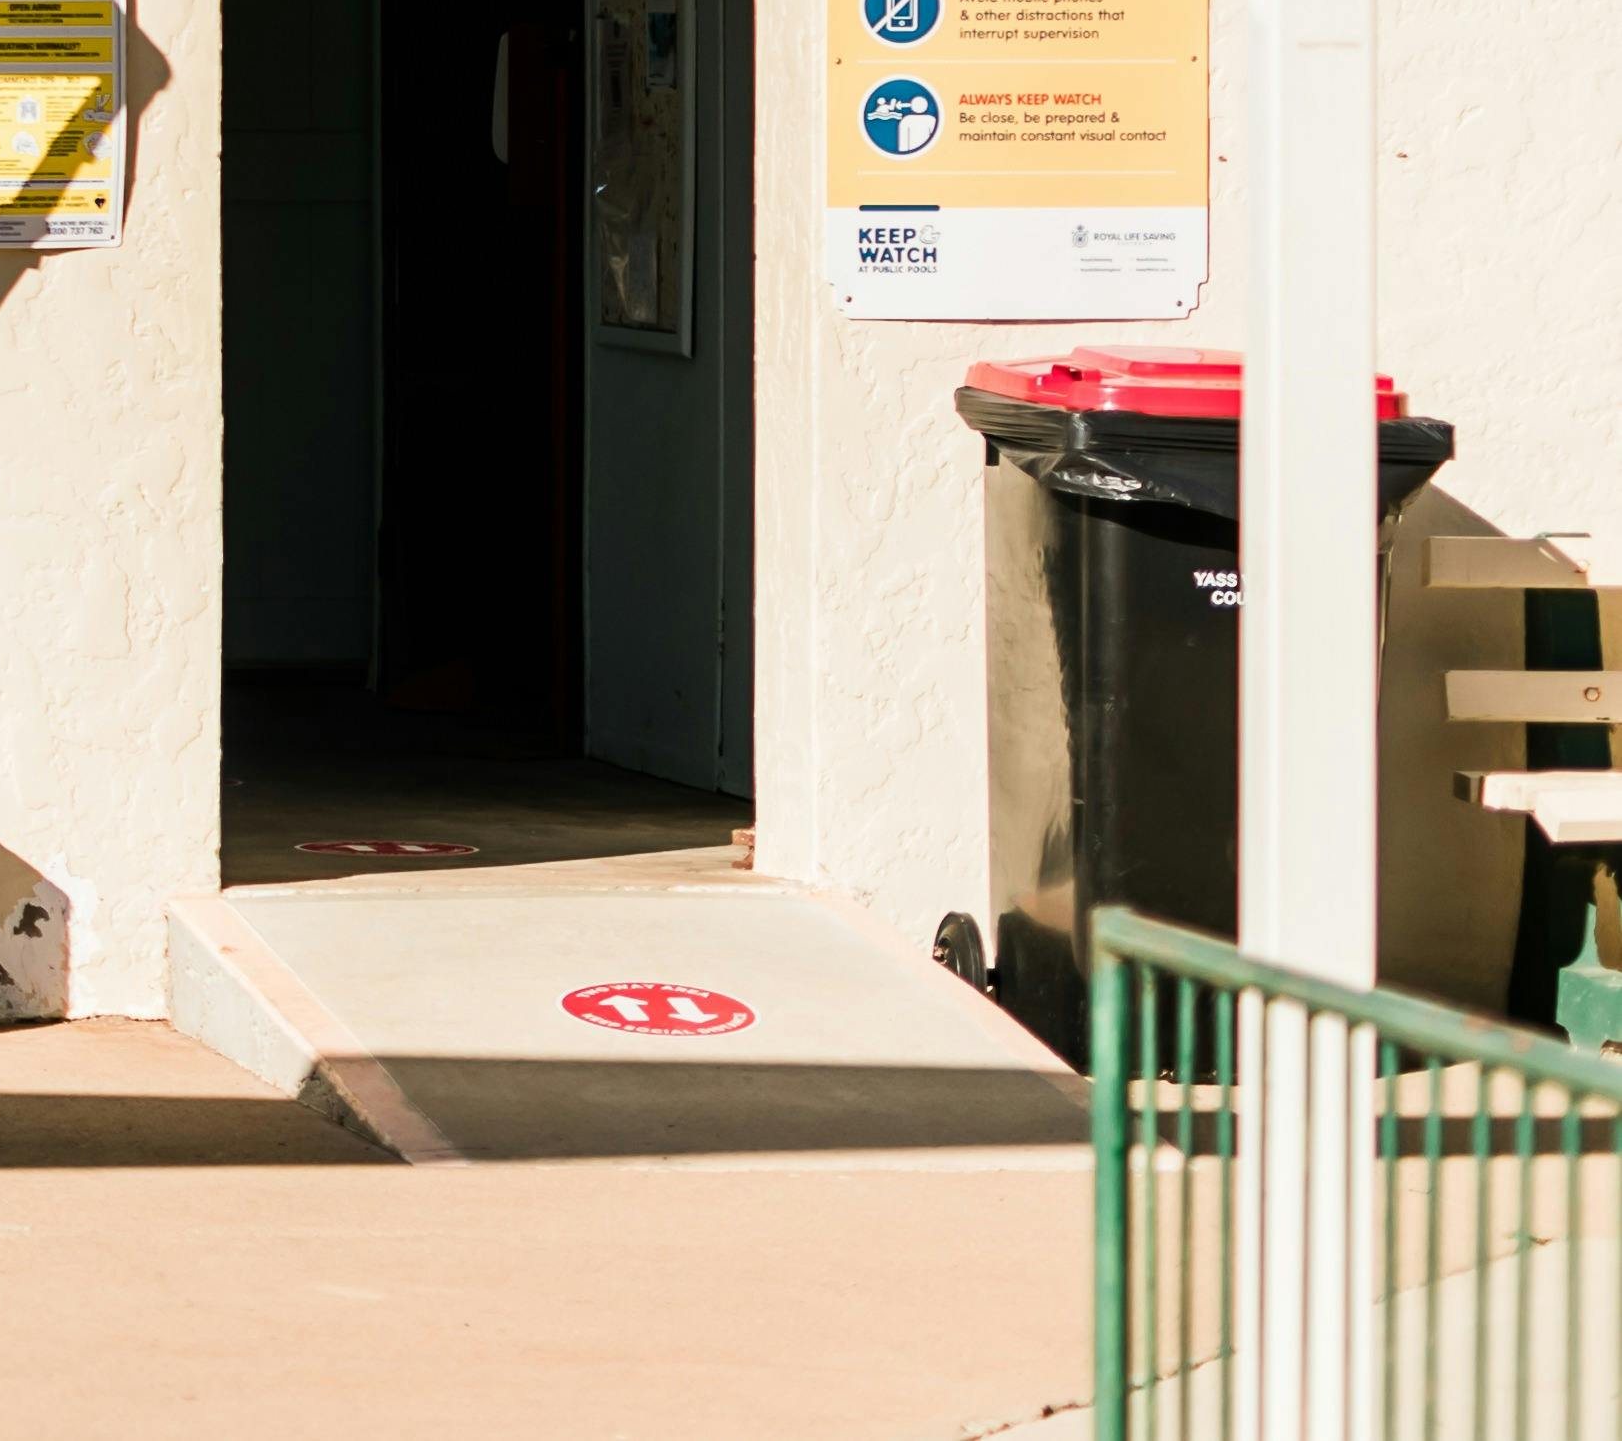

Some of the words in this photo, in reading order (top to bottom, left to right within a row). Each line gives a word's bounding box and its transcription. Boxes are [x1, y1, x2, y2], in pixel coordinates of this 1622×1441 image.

[960, 10, 970, 22] &
[975, 9, 1012, 22] other
[1016, 9, 1095, 22] distractions
[1099, 9, 1125, 22] that
[960, 27, 1019, 43] interrupt
[1024, 28, 1100, 43] supervision
[960, 93, 1013, 106] ALWAYS
[1017, 93, 1050, 106] KEEP
[1053, 93, 1102, 106] WATCH
[960, 112, 977, 125] Be
[981, 112, 1019, 127] close,
[1024, 112, 1042, 125] be
[1046, 112, 1106, 128] prepared
[1111, 113, 1120, 125] &
[960, 129, 1016, 142] maintain
[1021, 129, 1076, 142] constant
[1080, 129, 1115, 142] visual
[1120, 129, 1167, 142] contact
[859, 228, 916, 244] KEEP
[1094, 233, 1121, 241] ROYAL
[1124, 233, 1140, 241] LIFE
[1143, 233, 1177, 241] SAVING
[859, 247, 937, 263] WATCH
[1193, 571, 1238, 588] YASS
[576, 986, 609, 998] TWO
[660, 985, 710, 998] AREA
[582, 1013, 622, 1028] KEEP
[624, 1025, 696, 1035] SOCIAL
